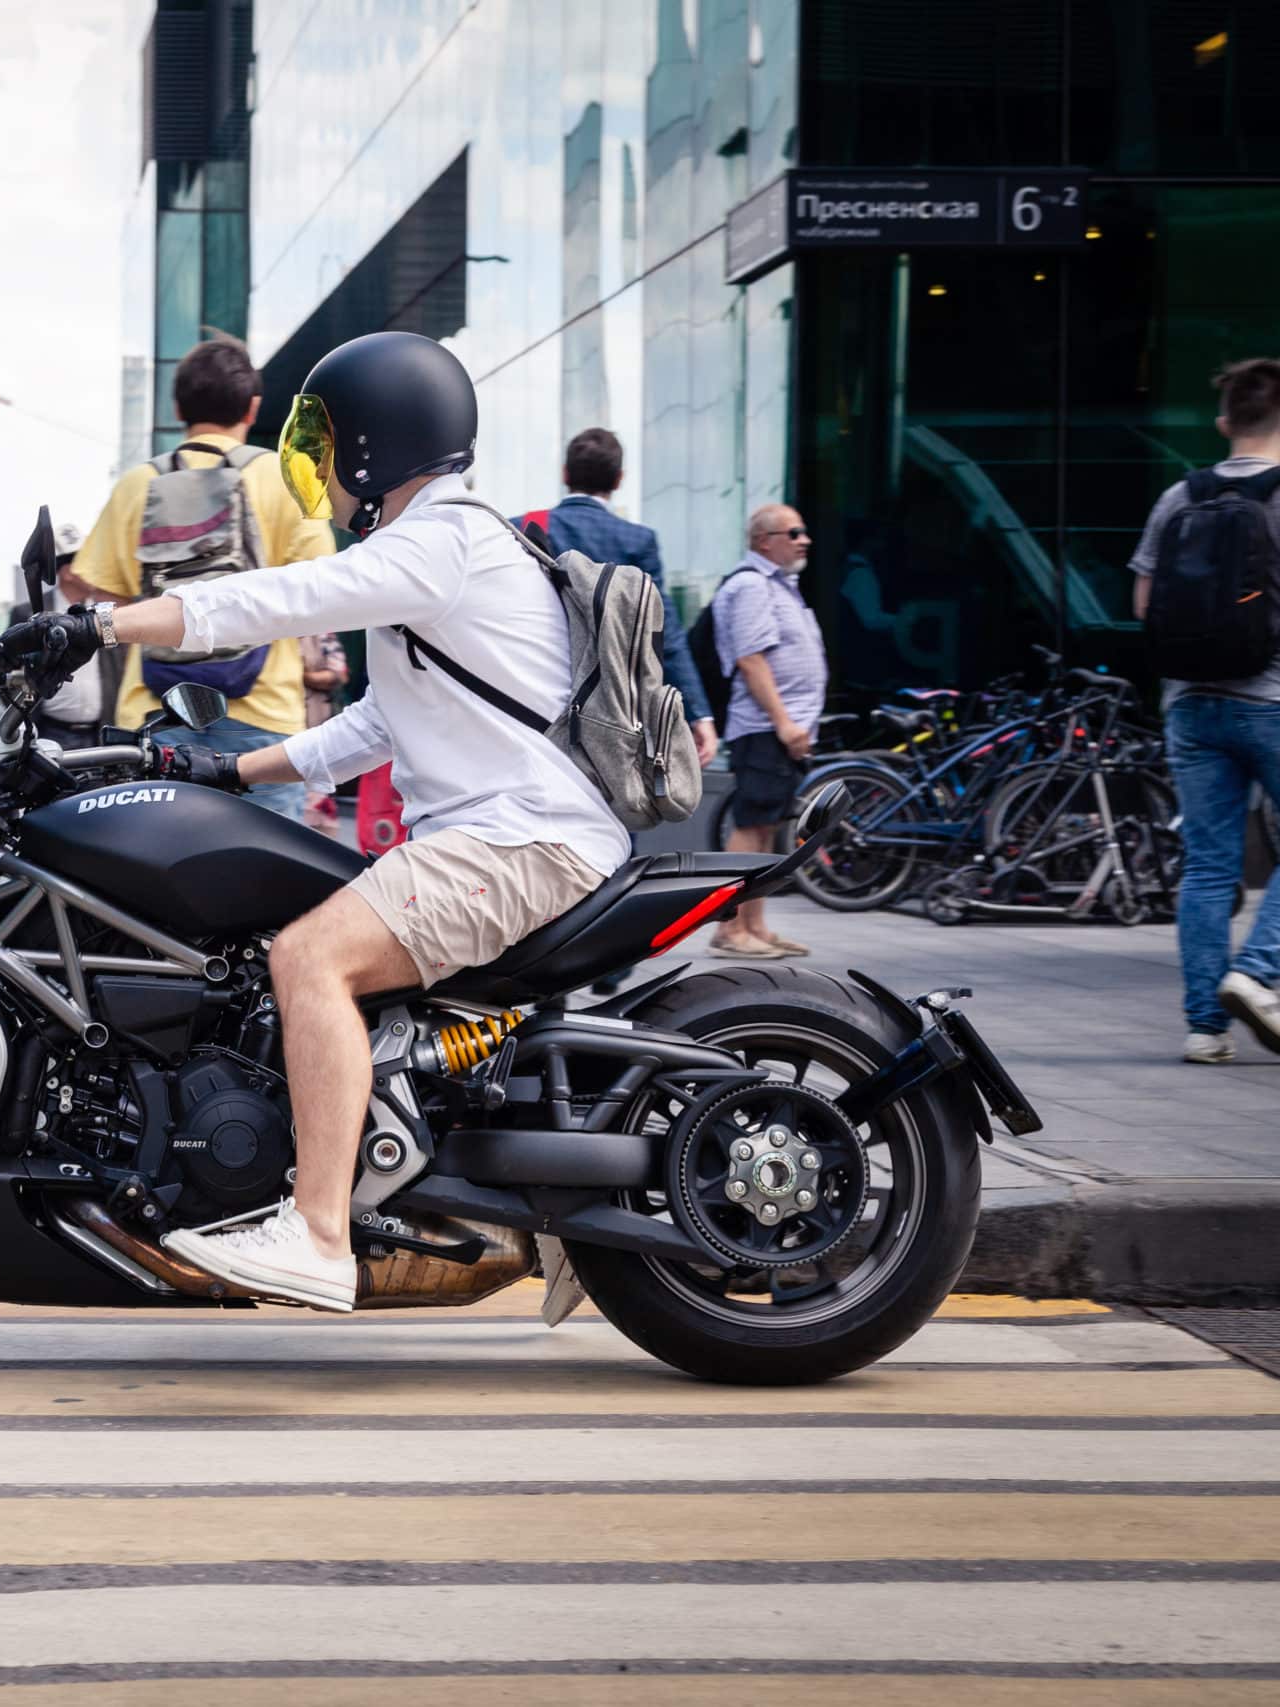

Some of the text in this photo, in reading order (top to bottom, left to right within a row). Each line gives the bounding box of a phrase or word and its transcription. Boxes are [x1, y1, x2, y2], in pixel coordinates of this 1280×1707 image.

[796, 194, 980, 223] Пресненская
[1012, 186, 1080, 231] 6 2
[78, 788, 177, 815] DUCATI
[172, 1140, 207, 1149] DUCATI
